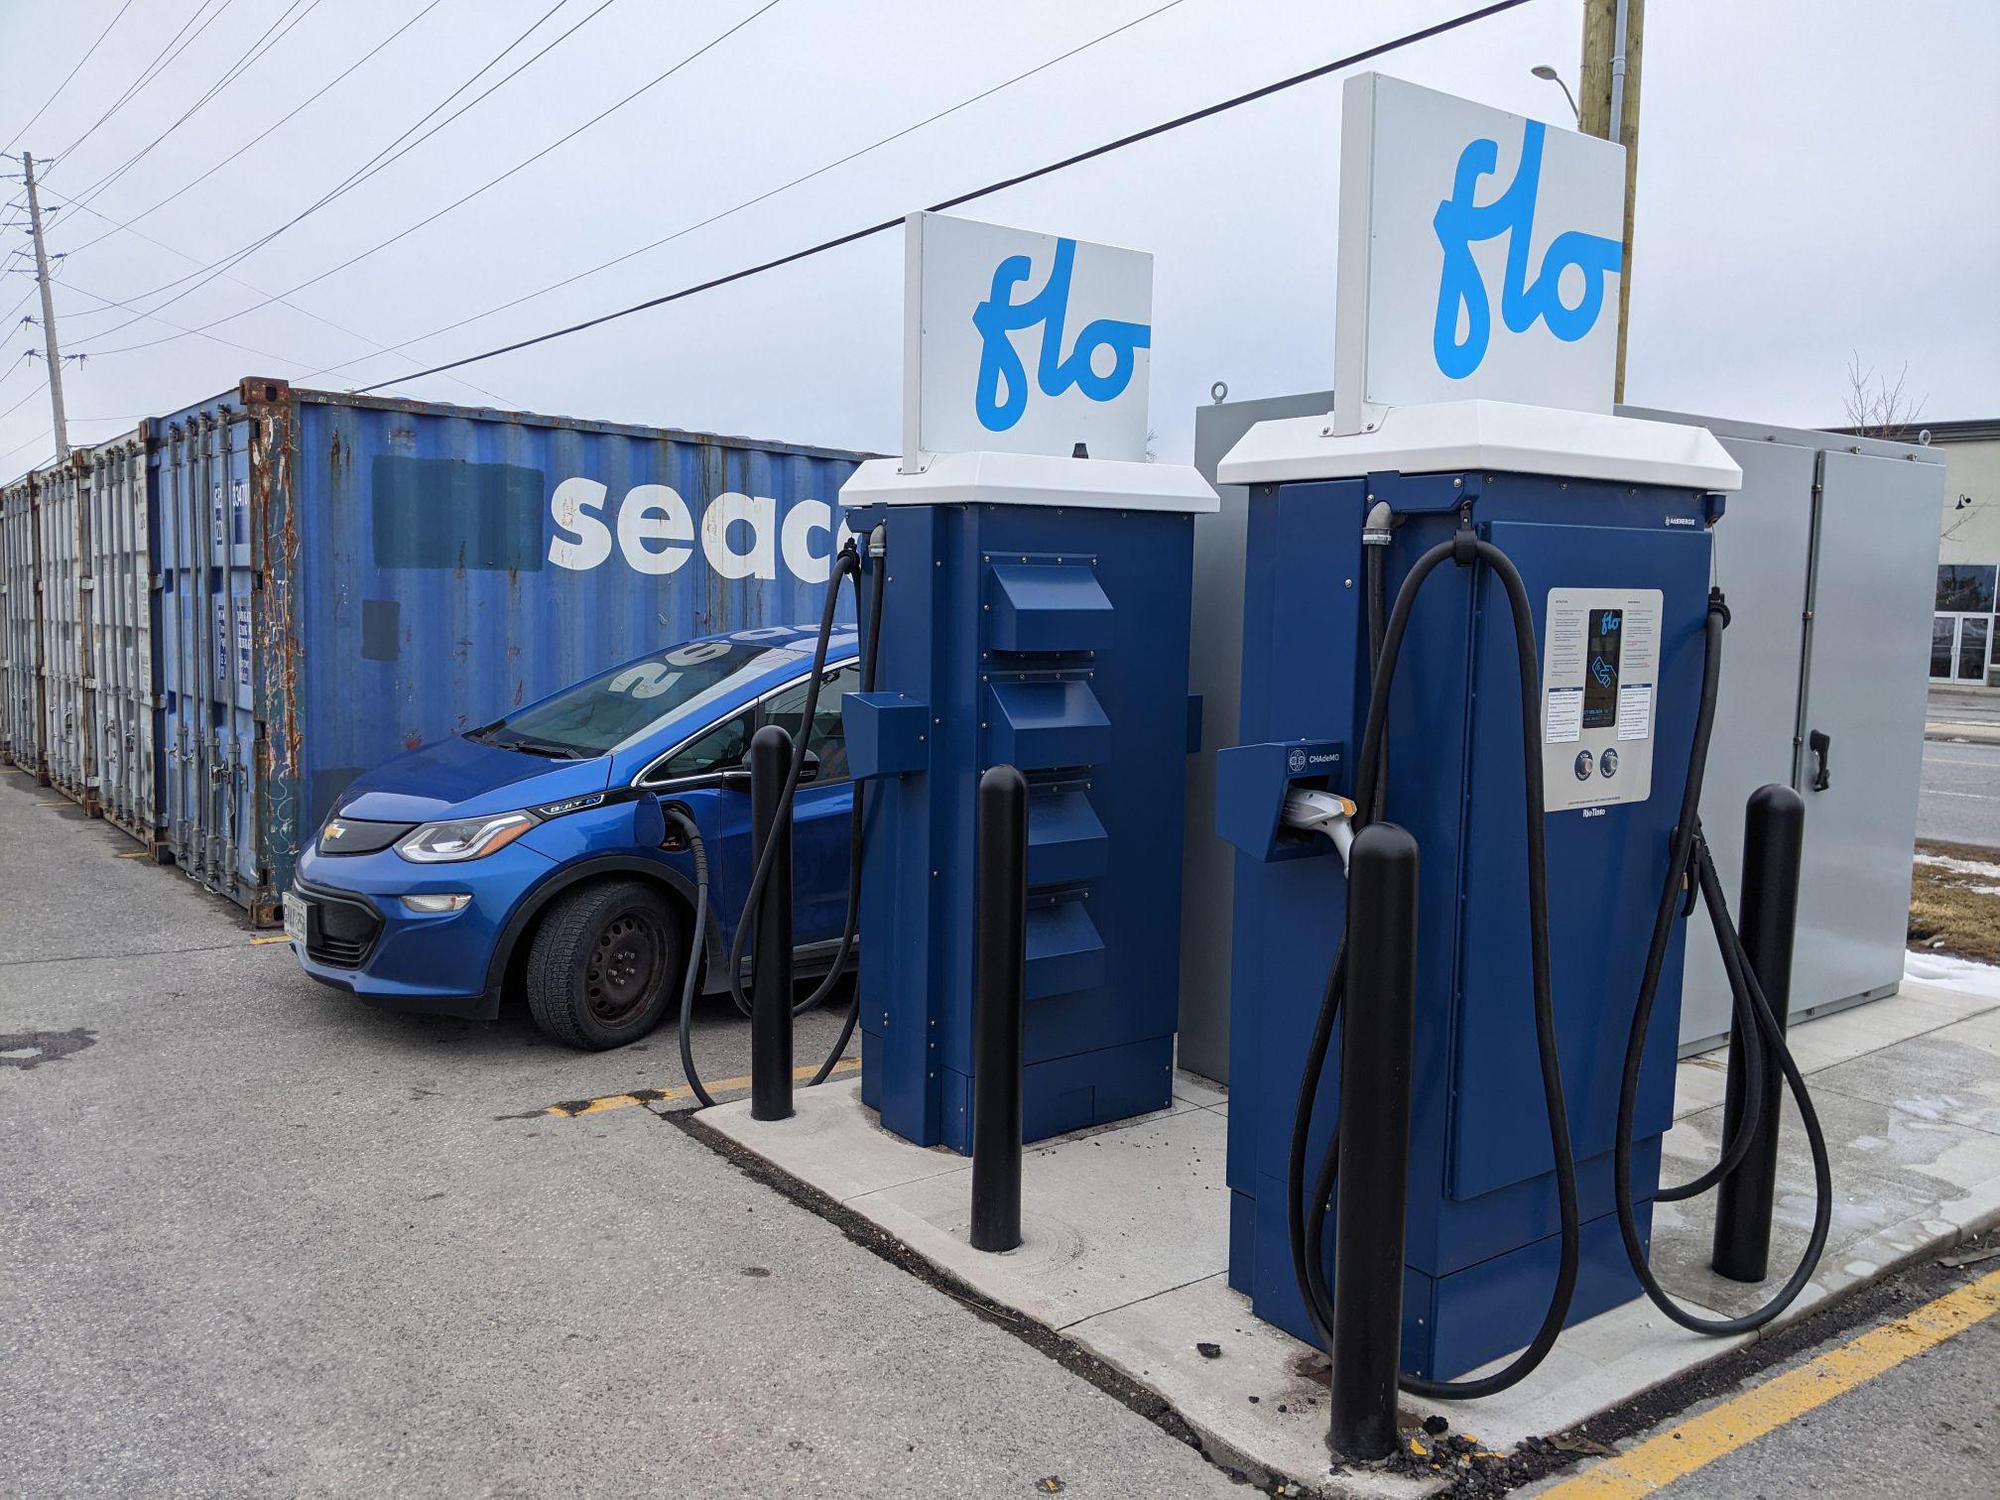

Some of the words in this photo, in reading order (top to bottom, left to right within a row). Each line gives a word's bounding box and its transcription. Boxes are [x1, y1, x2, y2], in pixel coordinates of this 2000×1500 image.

[972, 237, 1151, 432] flo
[1433, 118, 1623, 380] flo
[1601, 611, 1622, 636] flo
